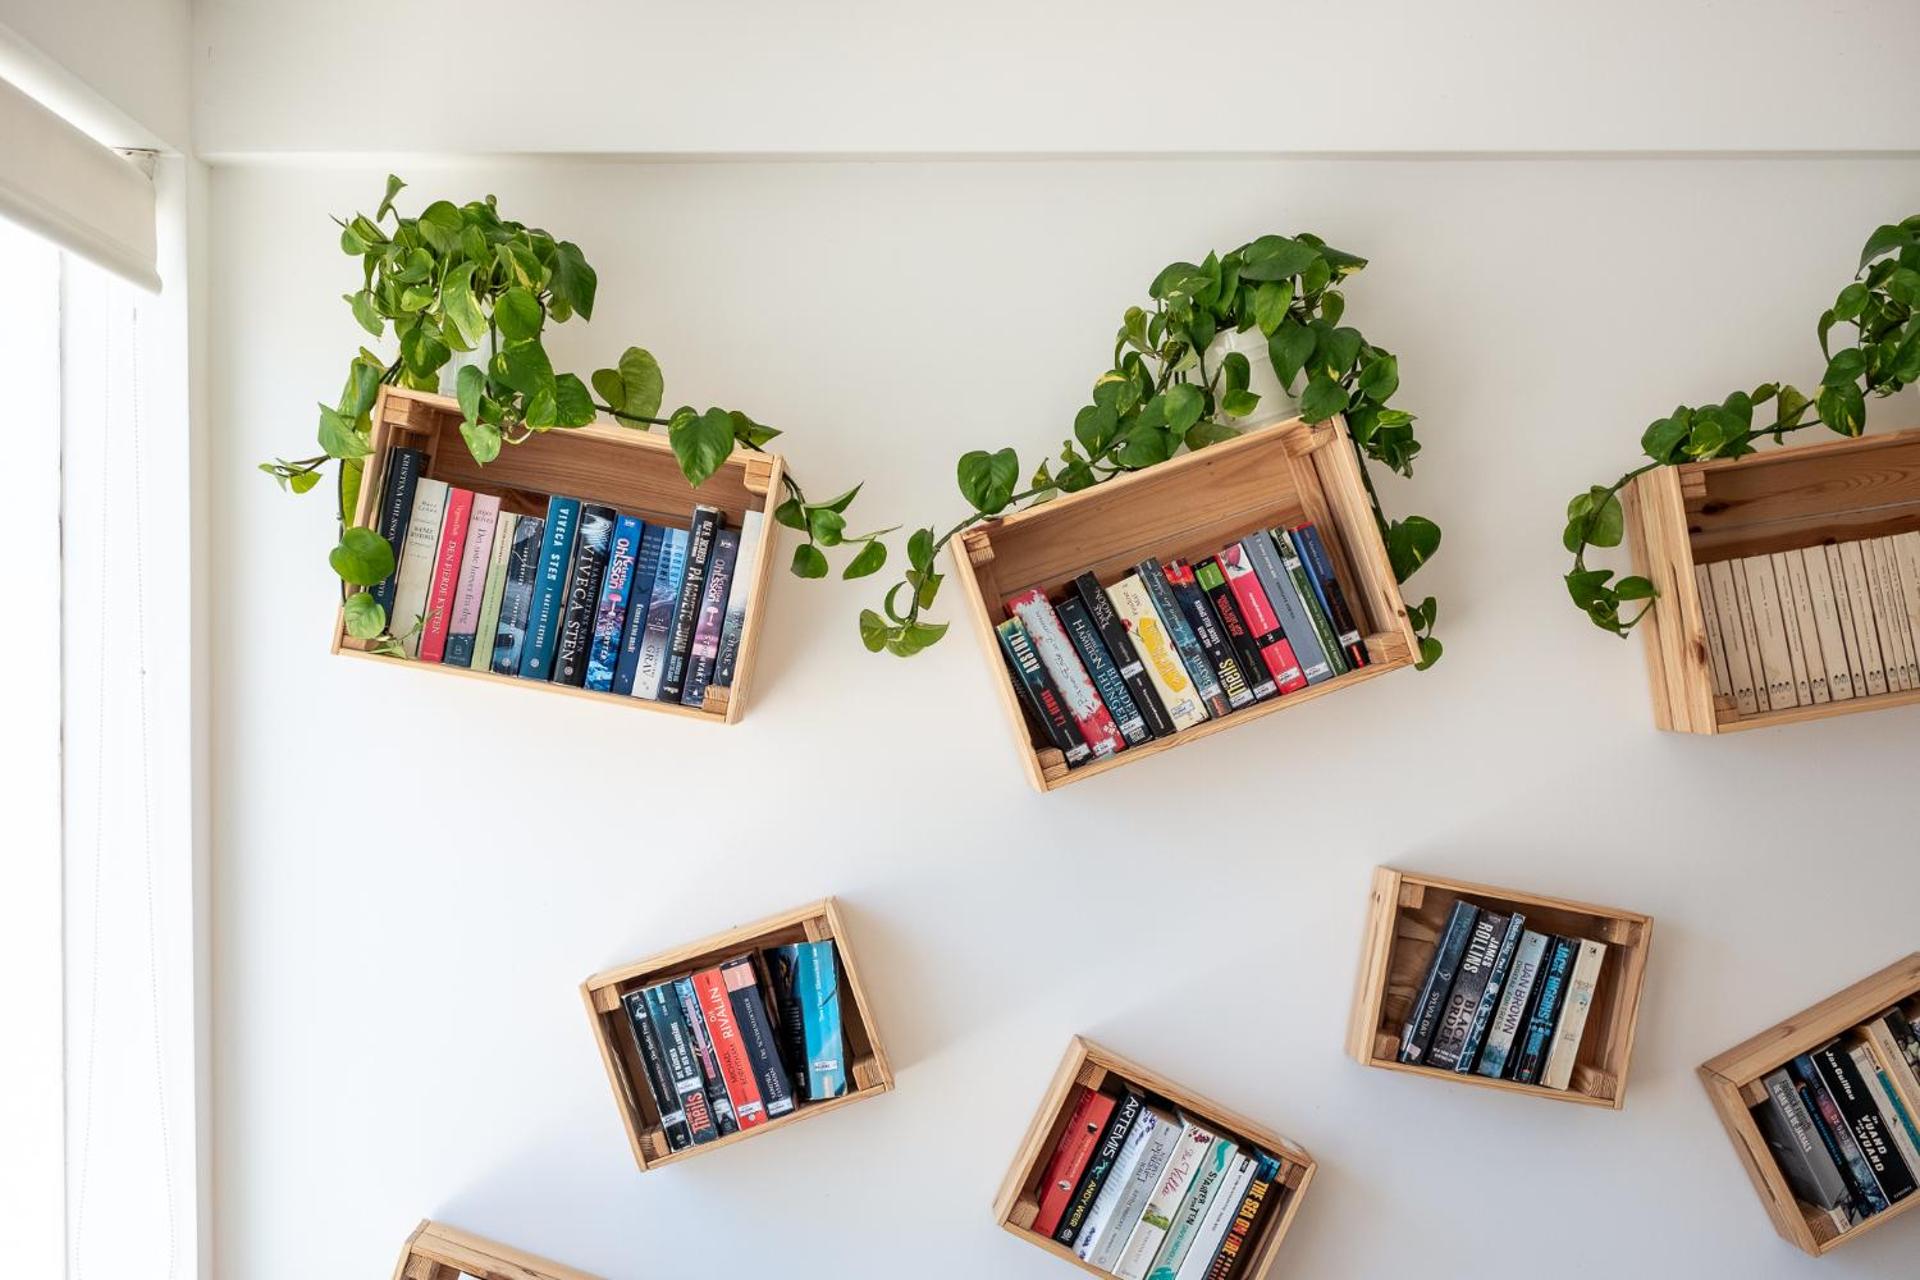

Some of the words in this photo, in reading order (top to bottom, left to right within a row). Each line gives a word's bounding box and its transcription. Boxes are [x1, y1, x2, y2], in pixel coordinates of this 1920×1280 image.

[394, 452, 411, 497] KRISTINA
[552, 507, 569, 547] VIVECA
[445, 540, 456, 561] DEN
[546, 553, 560, 581] STEN
[607, 537, 630, 590] Ohlsson
[568, 542, 598, 613] VIVECA
[687, 566, 704, 582] PÅ
[706, 558, 726, 603] Ohlsson
[558, 618, 581, 663] STEN
[1007, 629, 1040, 674] ABSTURZ
[1071, 617, 1106, 670] HAMILTON
[1095, 671, 1129, 725] HUNGER
[1106, 666, 1140, 720] BLINDER
[1462, 920, 1493, 974] ROLLINS
[1481, 936, 1500, 968] JAMES
[1550, 942, 1571, 974] JACK
[1517, 961, 1534, 988] DAN
[707, 985, 734, 1039] RIVALIN
[1424, 990, 1440, 1019] SYLVIA
[1501, 988, 1526, 1035] BROWN
[1536, 974, 1561, 1020] HIGGINS
[1417, 1018, 1430, 1037] DAY
[1437, 992, 1465, 1046] ORDER
[1449, 998, 1476, 1049] BLACK
[722, 1051, 737, 1083] MICHAEL
[1824, 1048, 1839, 1069] Jan
[1833, 1066, 1857, 1102] Guillou
[1101, 1095, 1140, 1159] ARTEMIS
[1080, 1179, 1098, 1205] ANDY
[1159, 1160, 1190, 1201] Villa
[1192, 1169, 1219, 1205] STARTER
[1248, 1178, 1269, 1201] THE
[1068, 1203, 1086, 1228] WEIR
[1184, 1206, 1200, 1226] TEN
[1231, 1216, 1251, 1236] ON
[1238, 1196, 1260, 1220] SEA
[1221, 1232, 1244, 1258] FIRE
